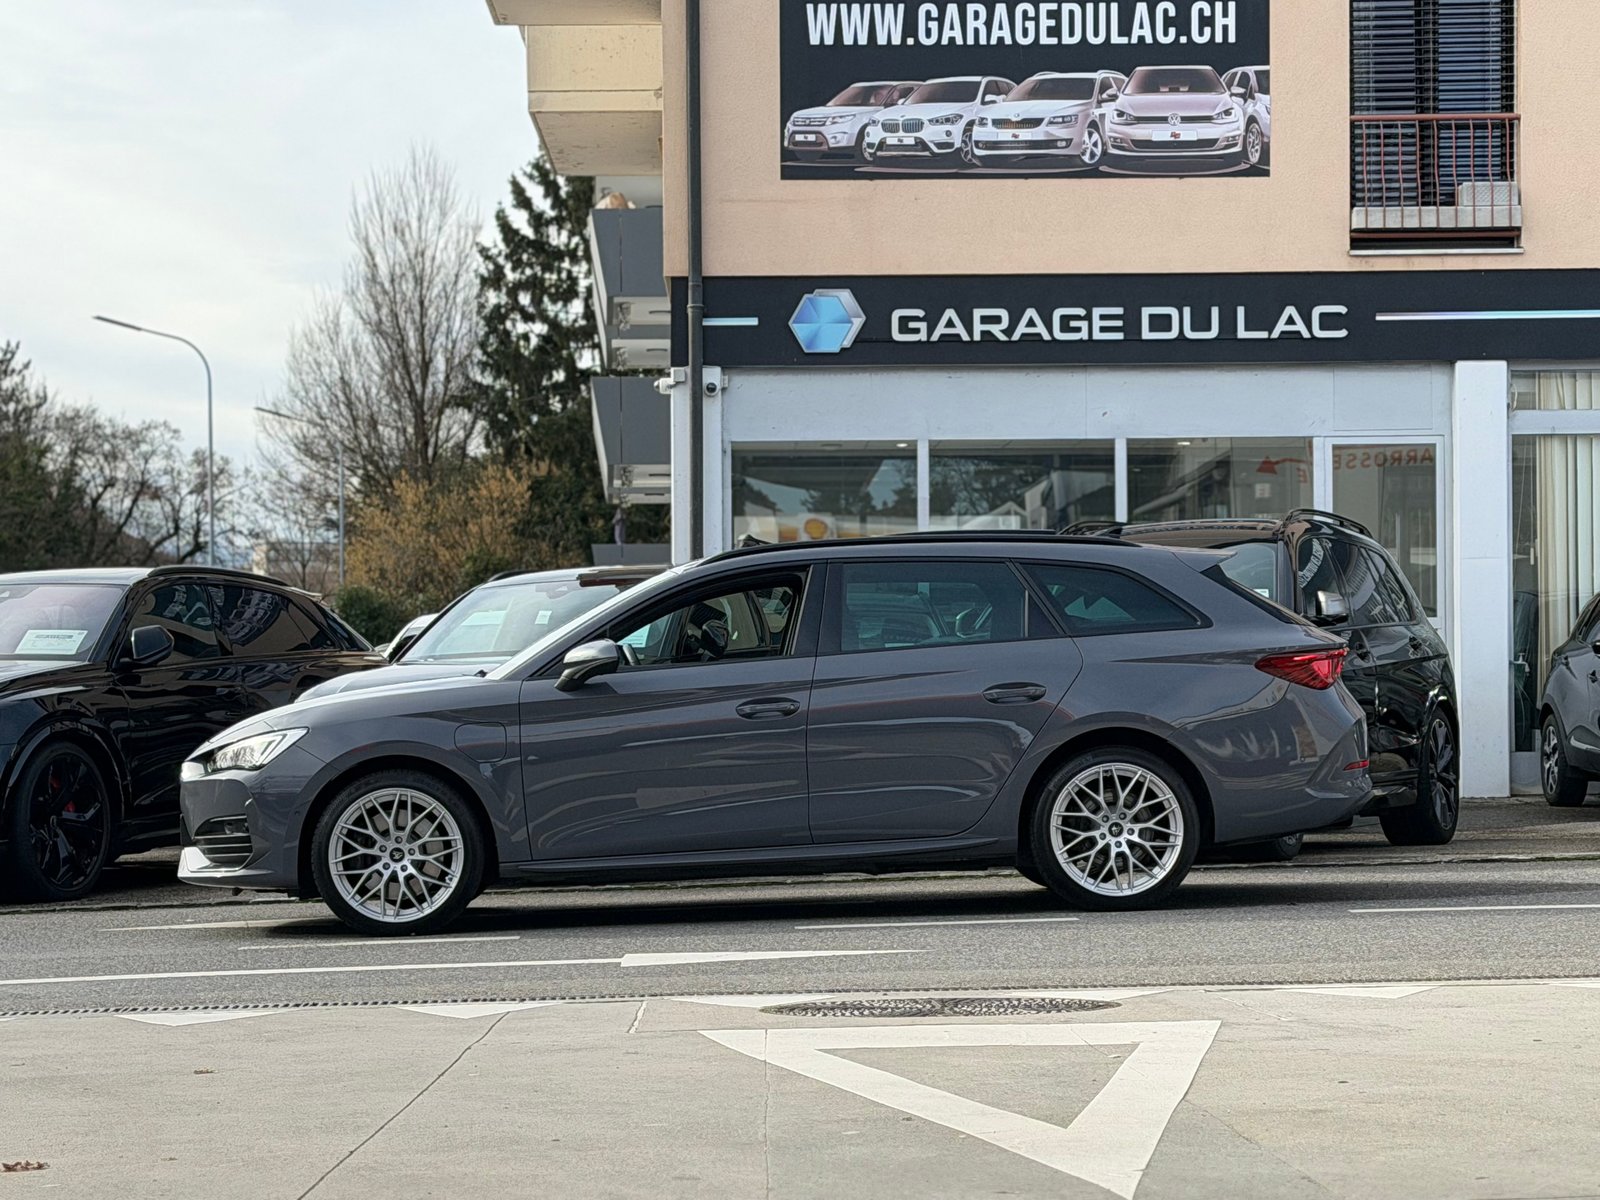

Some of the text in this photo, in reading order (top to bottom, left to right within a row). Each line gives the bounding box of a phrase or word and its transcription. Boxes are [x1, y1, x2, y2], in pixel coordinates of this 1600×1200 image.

[806, 1, 1237, 46] WWW.GARAGEDULAC.CH
[890, 304, 1349, 342] GARAGE DU LAC
